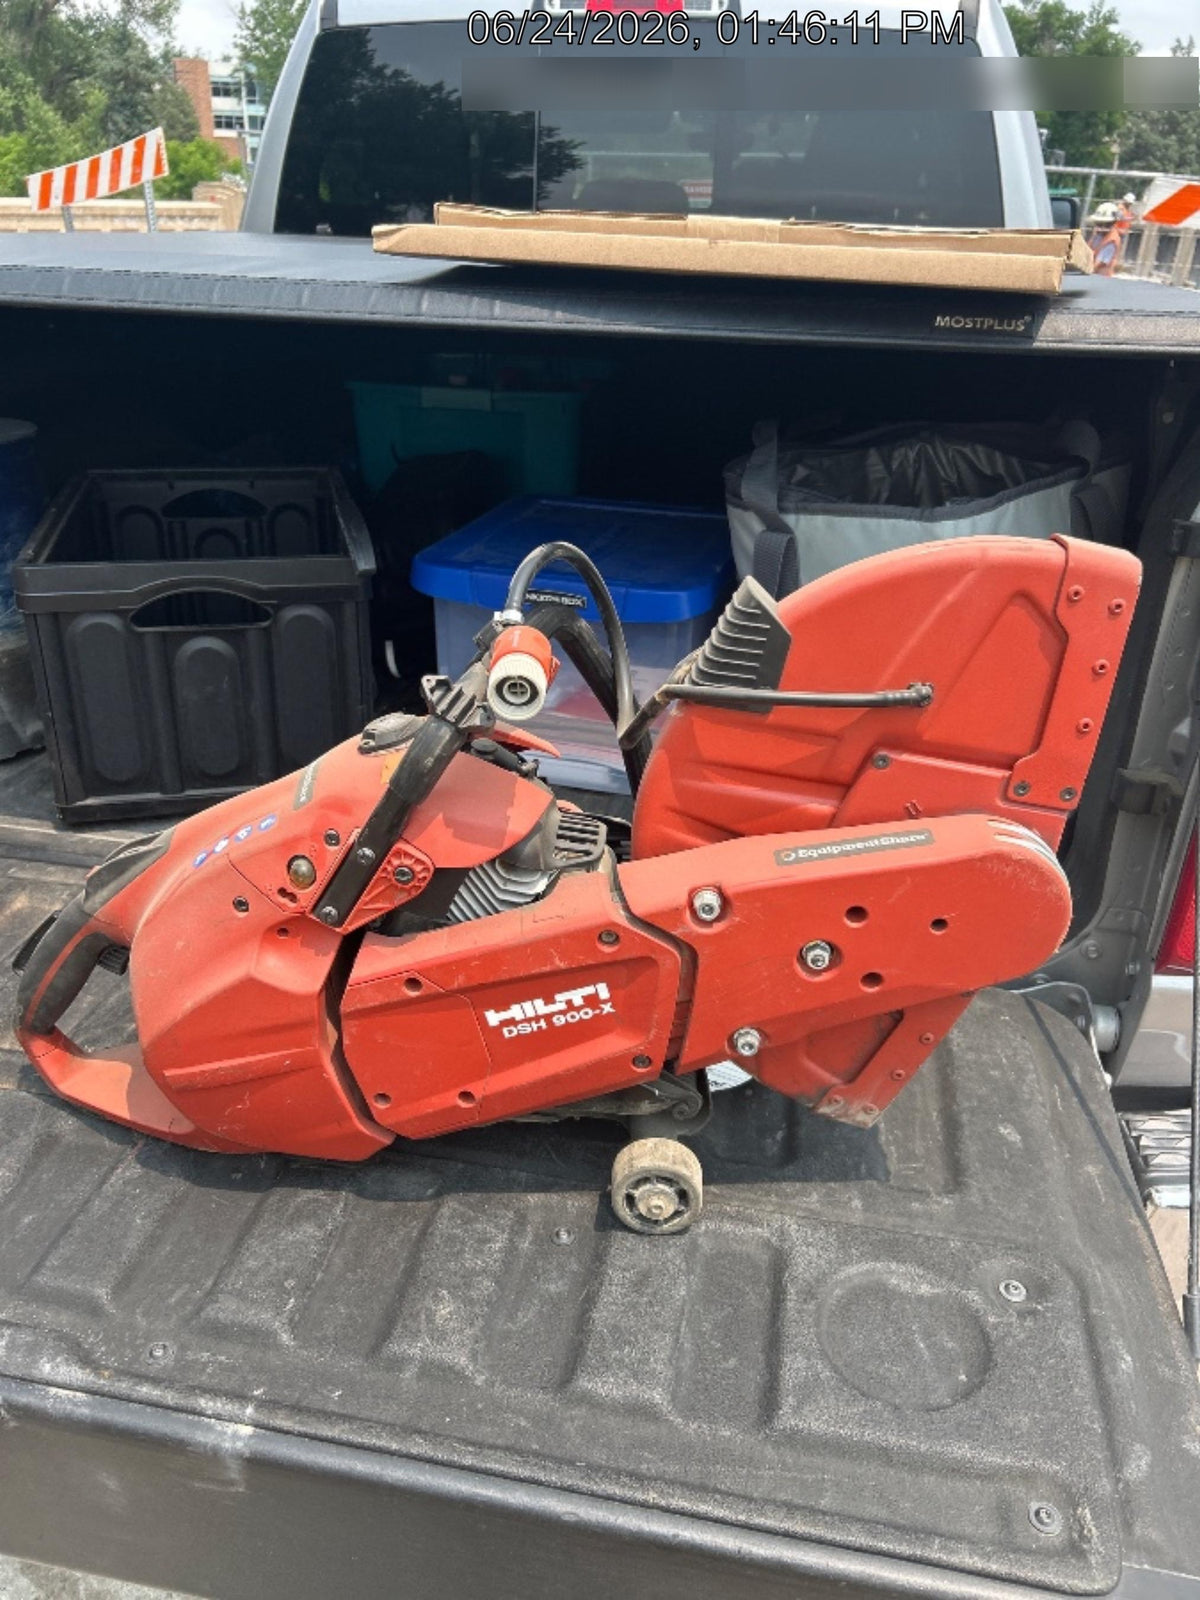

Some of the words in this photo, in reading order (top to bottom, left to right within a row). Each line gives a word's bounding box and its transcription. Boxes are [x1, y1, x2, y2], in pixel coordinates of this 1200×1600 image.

[484, 982, 610, 1027] HILTI
[502, 1018, 547, 1039] DSH
[552, 1001, 616, 1026] 900-X
